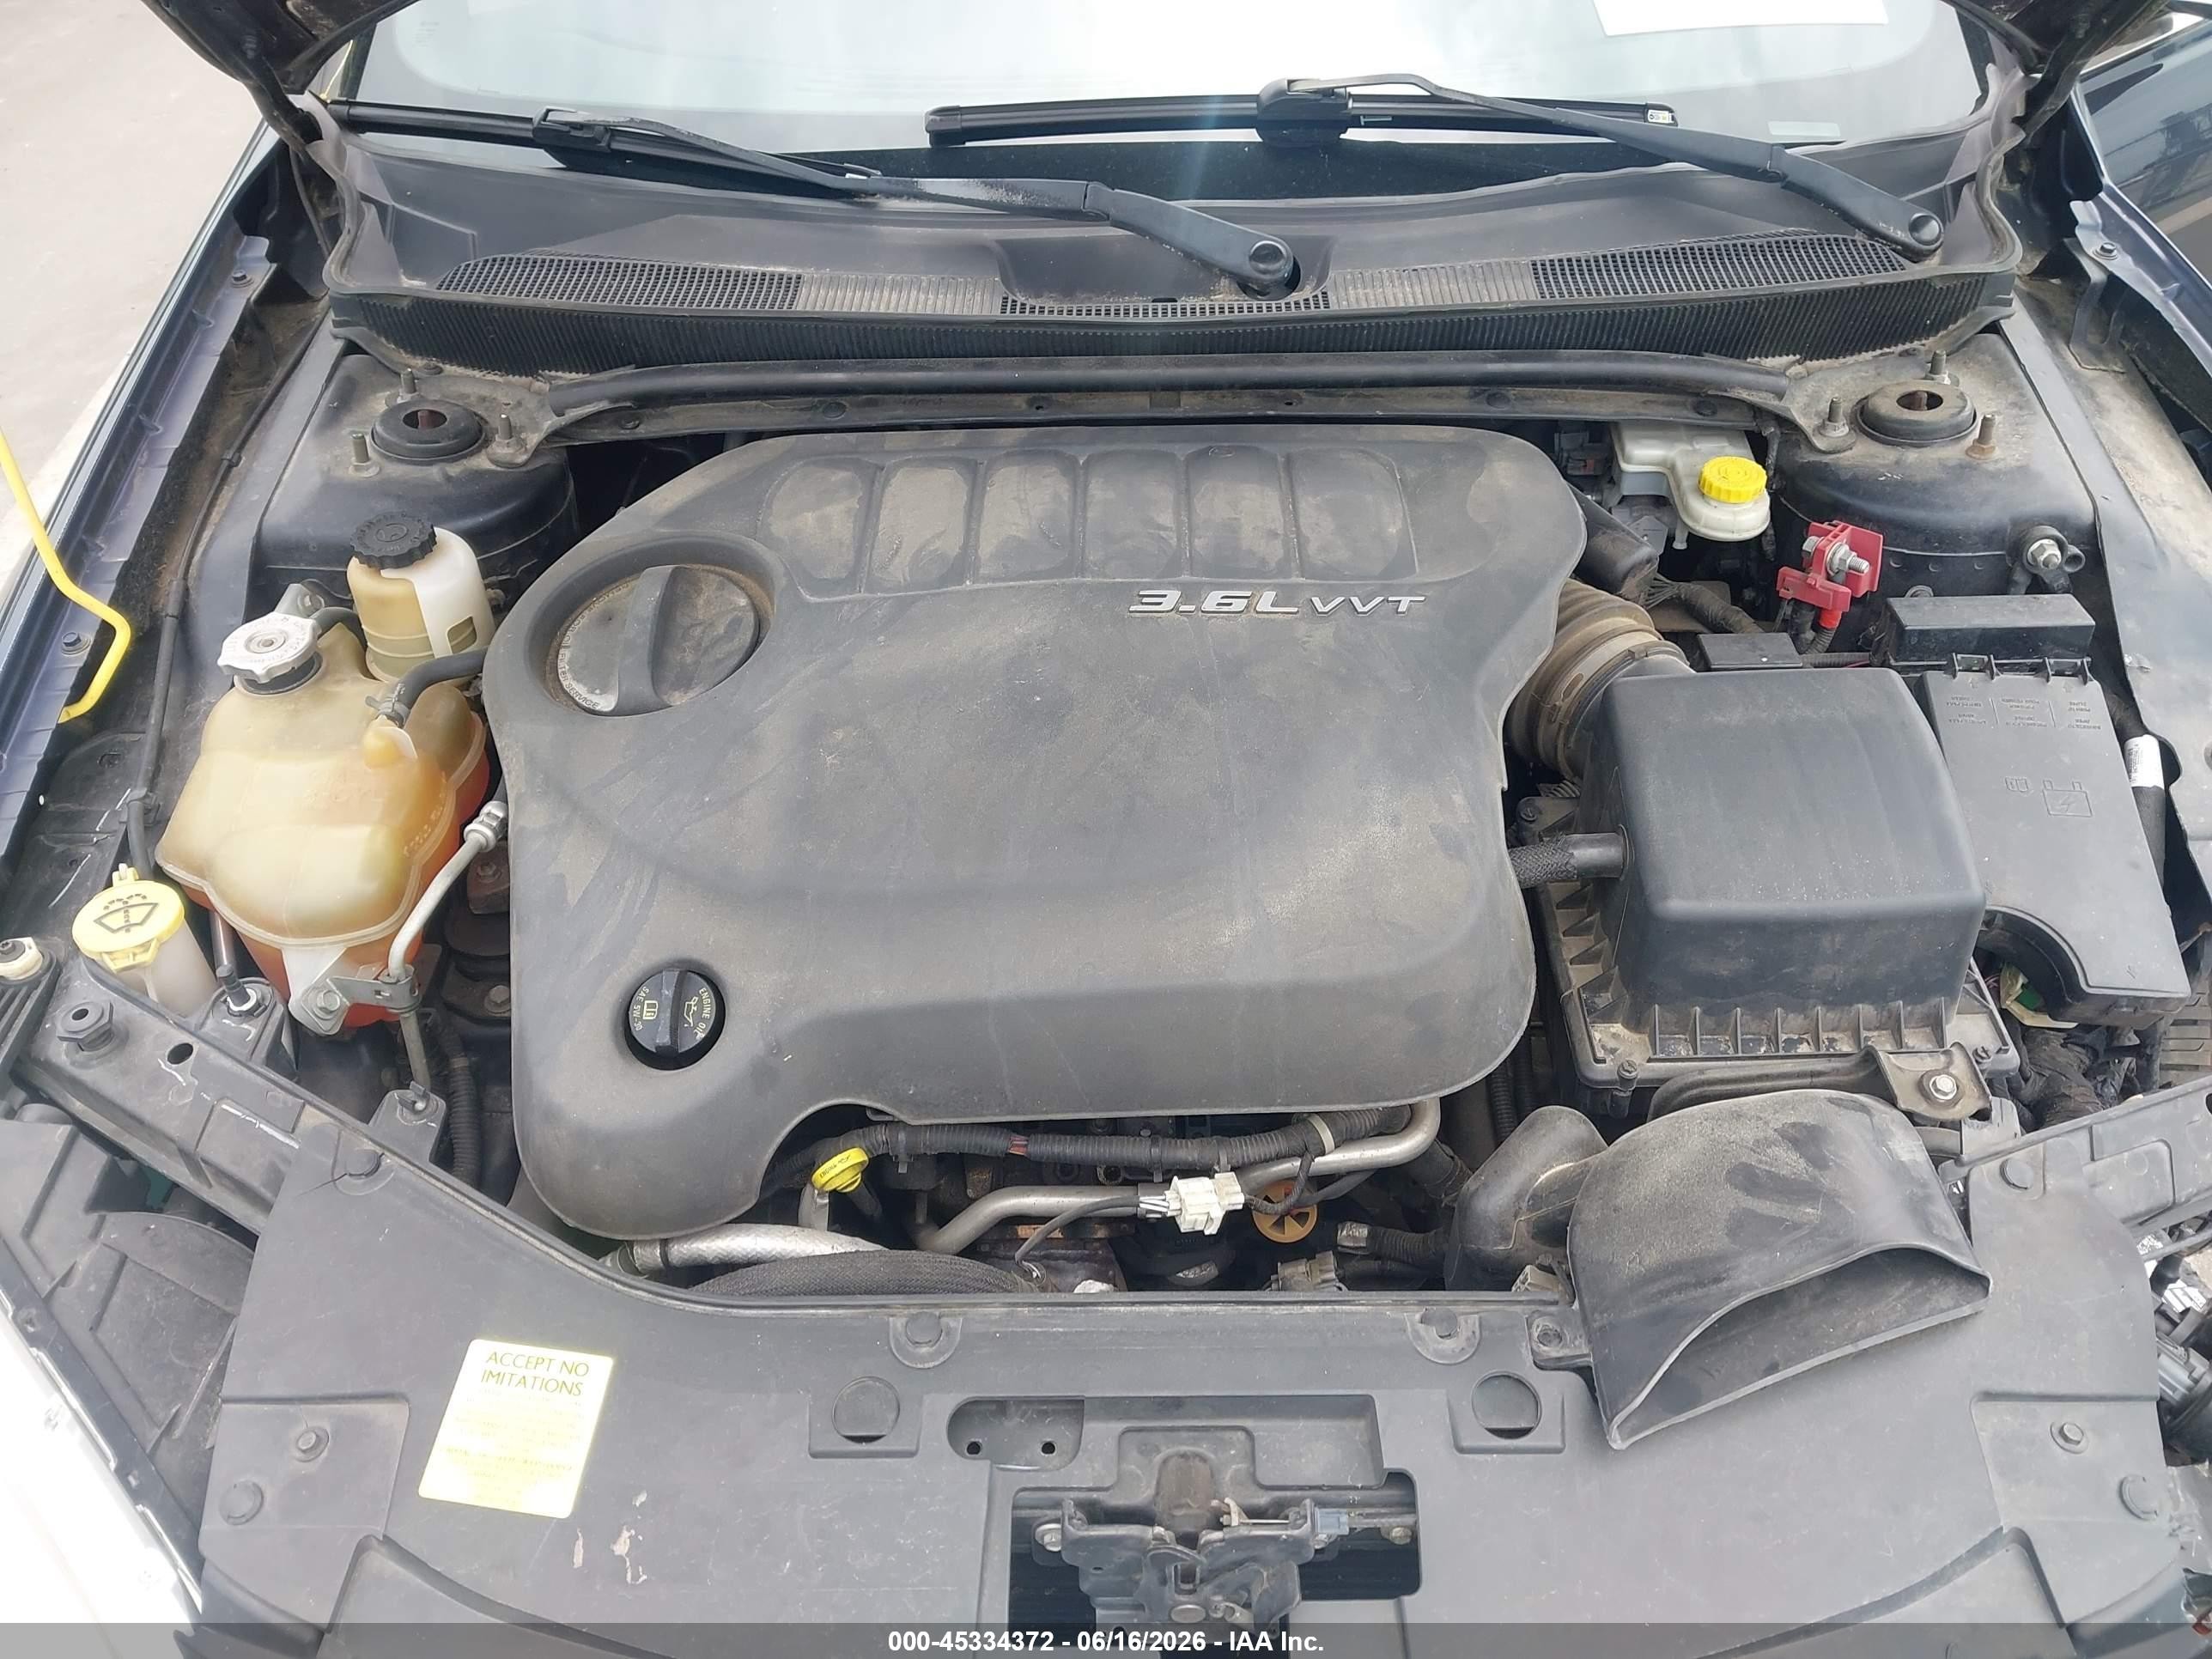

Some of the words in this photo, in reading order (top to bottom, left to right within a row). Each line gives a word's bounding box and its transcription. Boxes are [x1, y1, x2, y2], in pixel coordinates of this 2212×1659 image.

[1128, 589, 1300, 617] 3.6L
[1310, 595, 1426, 617] VVT
[570, 614, 586, 634] FOR
[559, 653, 568, 682] FILTER
[565, 683, 600, 709] SERVICE
[636, 987, 649, 1003] SAE
[698, 988, 712, 1020] ENGINE
[633, 1005, 644, 1031] 5W-30
[486, 1352, 556, 1371] ACCEPT
[560, 1360, 590, 1377] NO
[481, 1370, 584, 1396] IMITATIONS
